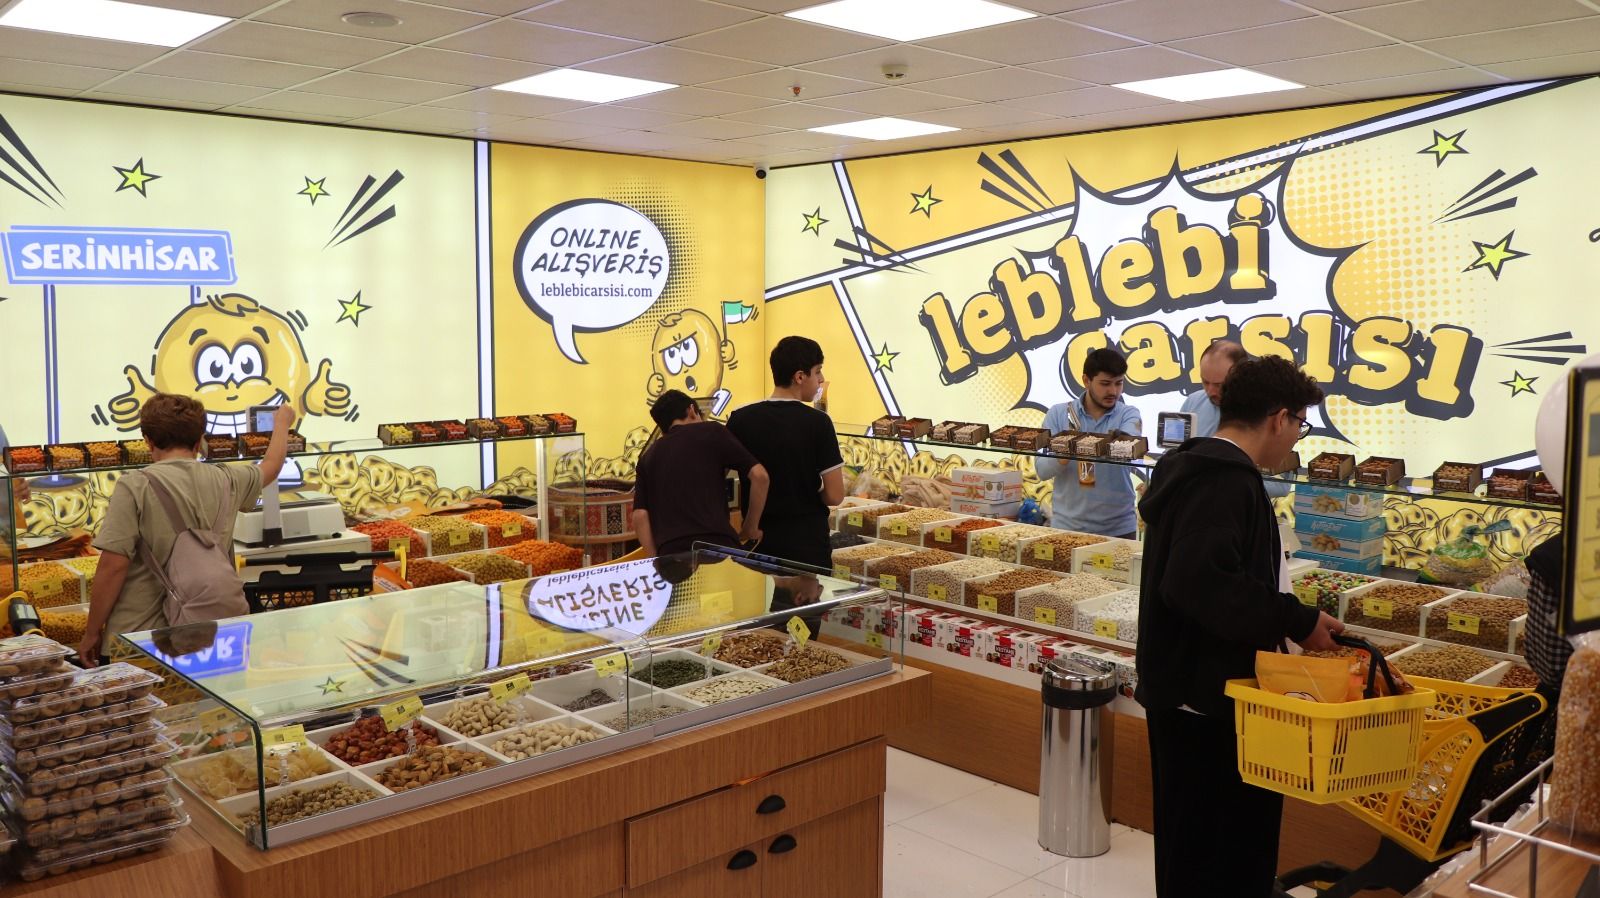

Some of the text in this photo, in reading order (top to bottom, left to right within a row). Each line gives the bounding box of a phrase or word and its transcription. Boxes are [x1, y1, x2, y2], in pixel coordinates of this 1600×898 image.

[550, 227, 641, 249] ONLINE
[21, 237, 220, 271] SERİNHİSAR
[531, 248, 663, 279] ALIŞVERİŞ
[541, 283, 652, 297] leblebicarsisi.com
[920, 192, 1274, 381] leblebi
